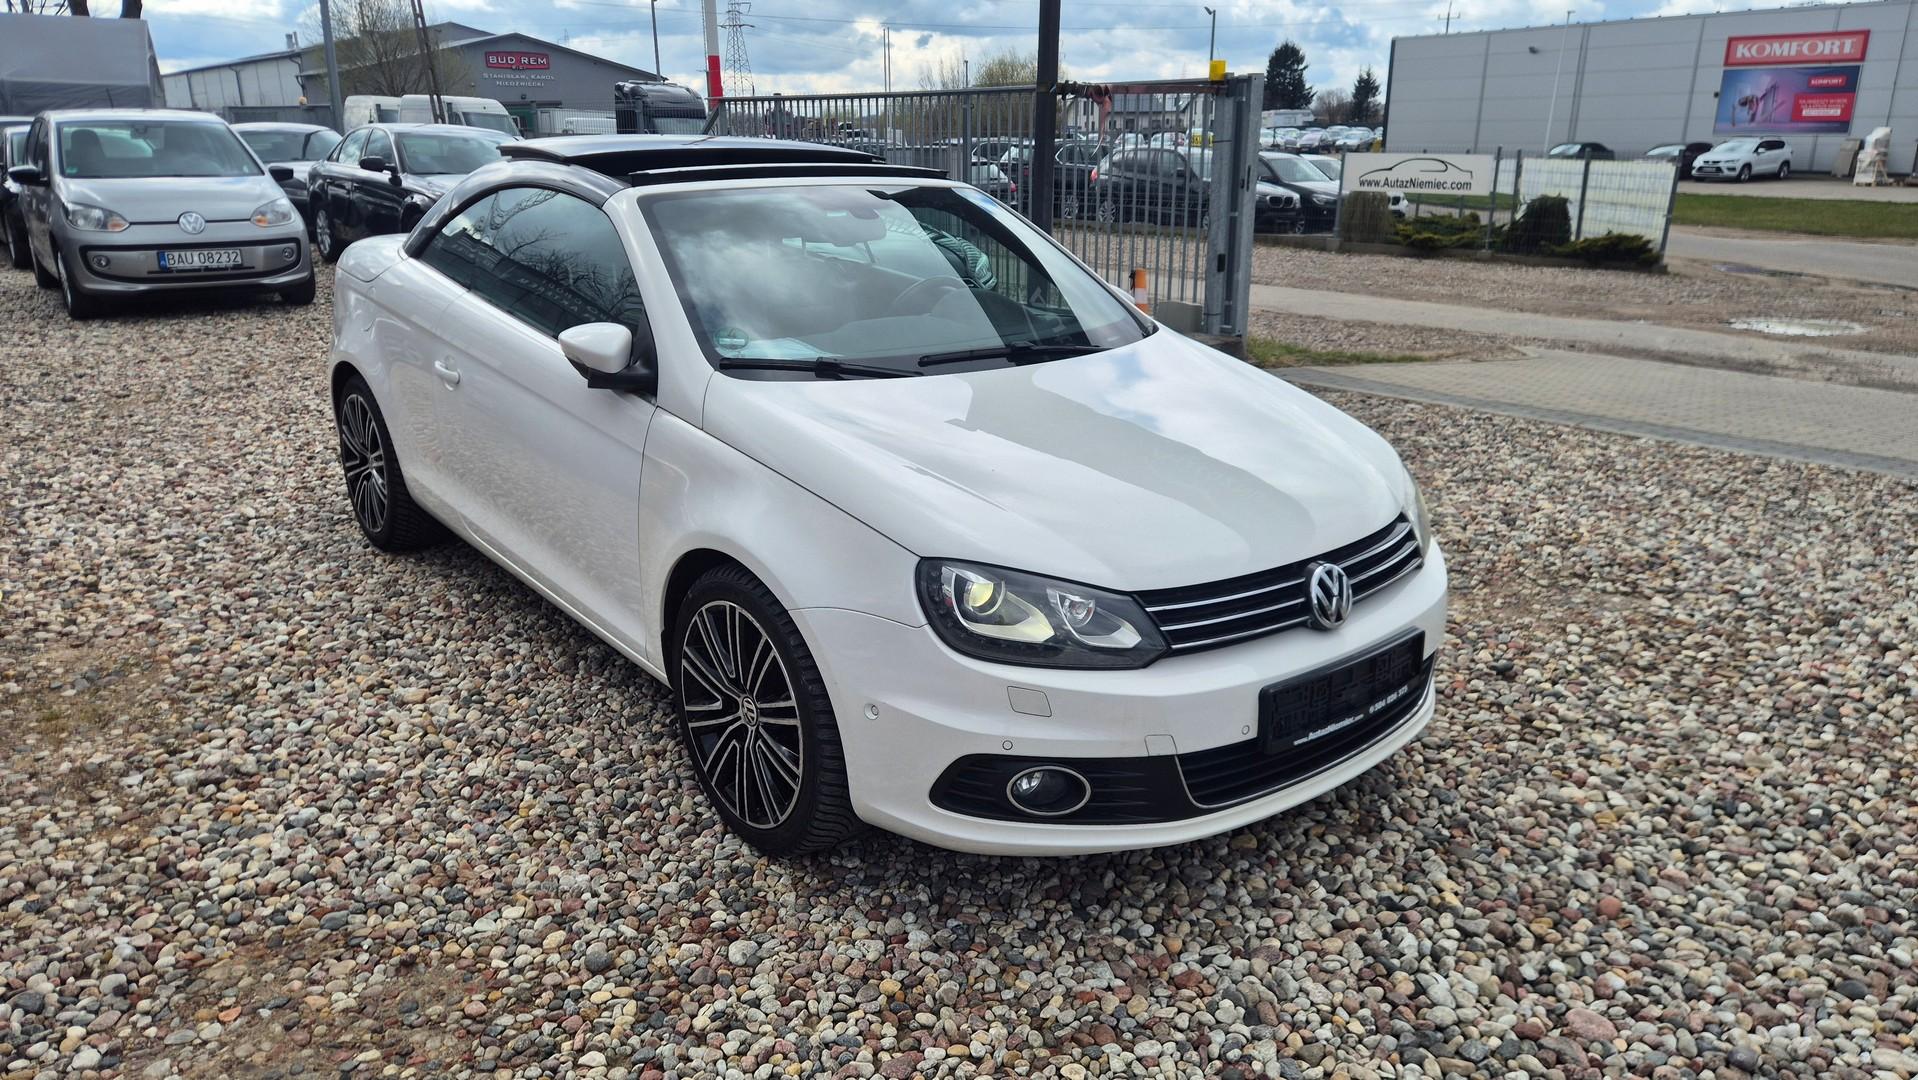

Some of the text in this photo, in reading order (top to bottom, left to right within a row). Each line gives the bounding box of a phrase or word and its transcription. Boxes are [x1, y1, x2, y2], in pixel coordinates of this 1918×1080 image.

[1735, 38, 1857, 59] KOMFORT
[488, 55, 547, 65] BUD REM
[1359, 176, 1472, 191] www.AutazNiemiec.com
[166, 250, 240, 266] BAU 08232
